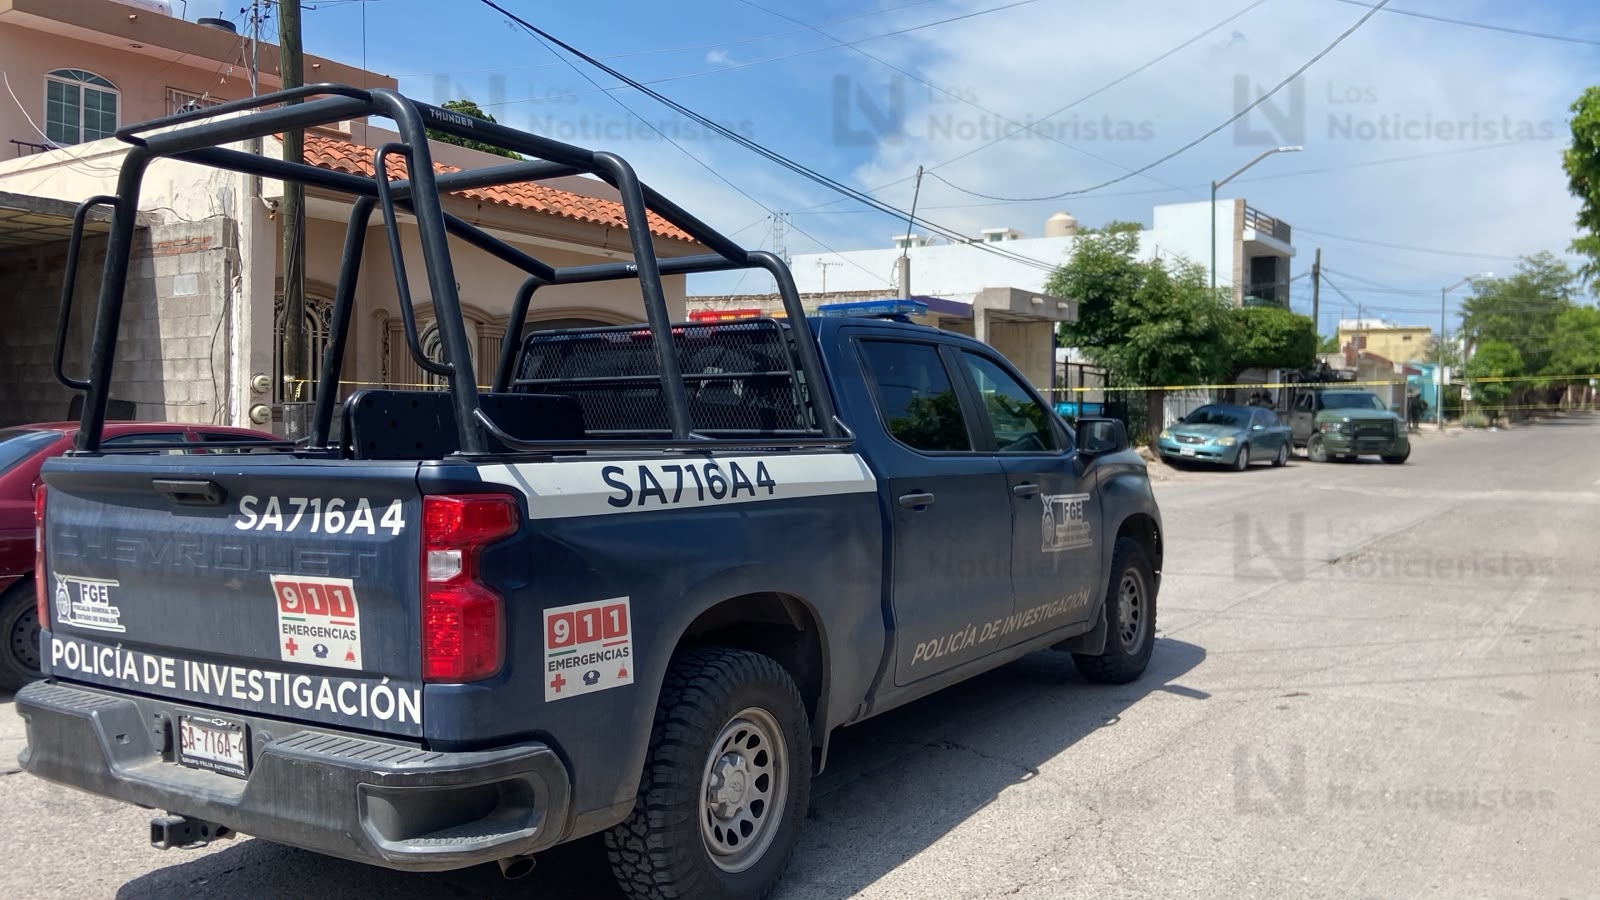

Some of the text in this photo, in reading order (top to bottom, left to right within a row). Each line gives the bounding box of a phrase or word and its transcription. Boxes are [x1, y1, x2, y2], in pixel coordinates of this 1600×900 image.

[429, 108, 474, 129] THUNDER
[601, 460, 776, 509] SA716A4
[234, 495, 406, 536] SA716A4
[1064, 502, 1082, 521] FGE
[56, 529, 379, 578] CHEVROLET
[81, 583, 108, 604] FGE
[280, 584, 350, 615] 911
[282, 624, 358, 641] EMERGENCIAS
[552, 606, 623, 644] 911
[911, 588, 1092, 667] POLICÍA DE INVESTIGACIÓN
[548, 647, 630, 672] EMERGENCIAS
[51, 637, 422, 725] POLICÍA DE INVESTIGACIÓN
